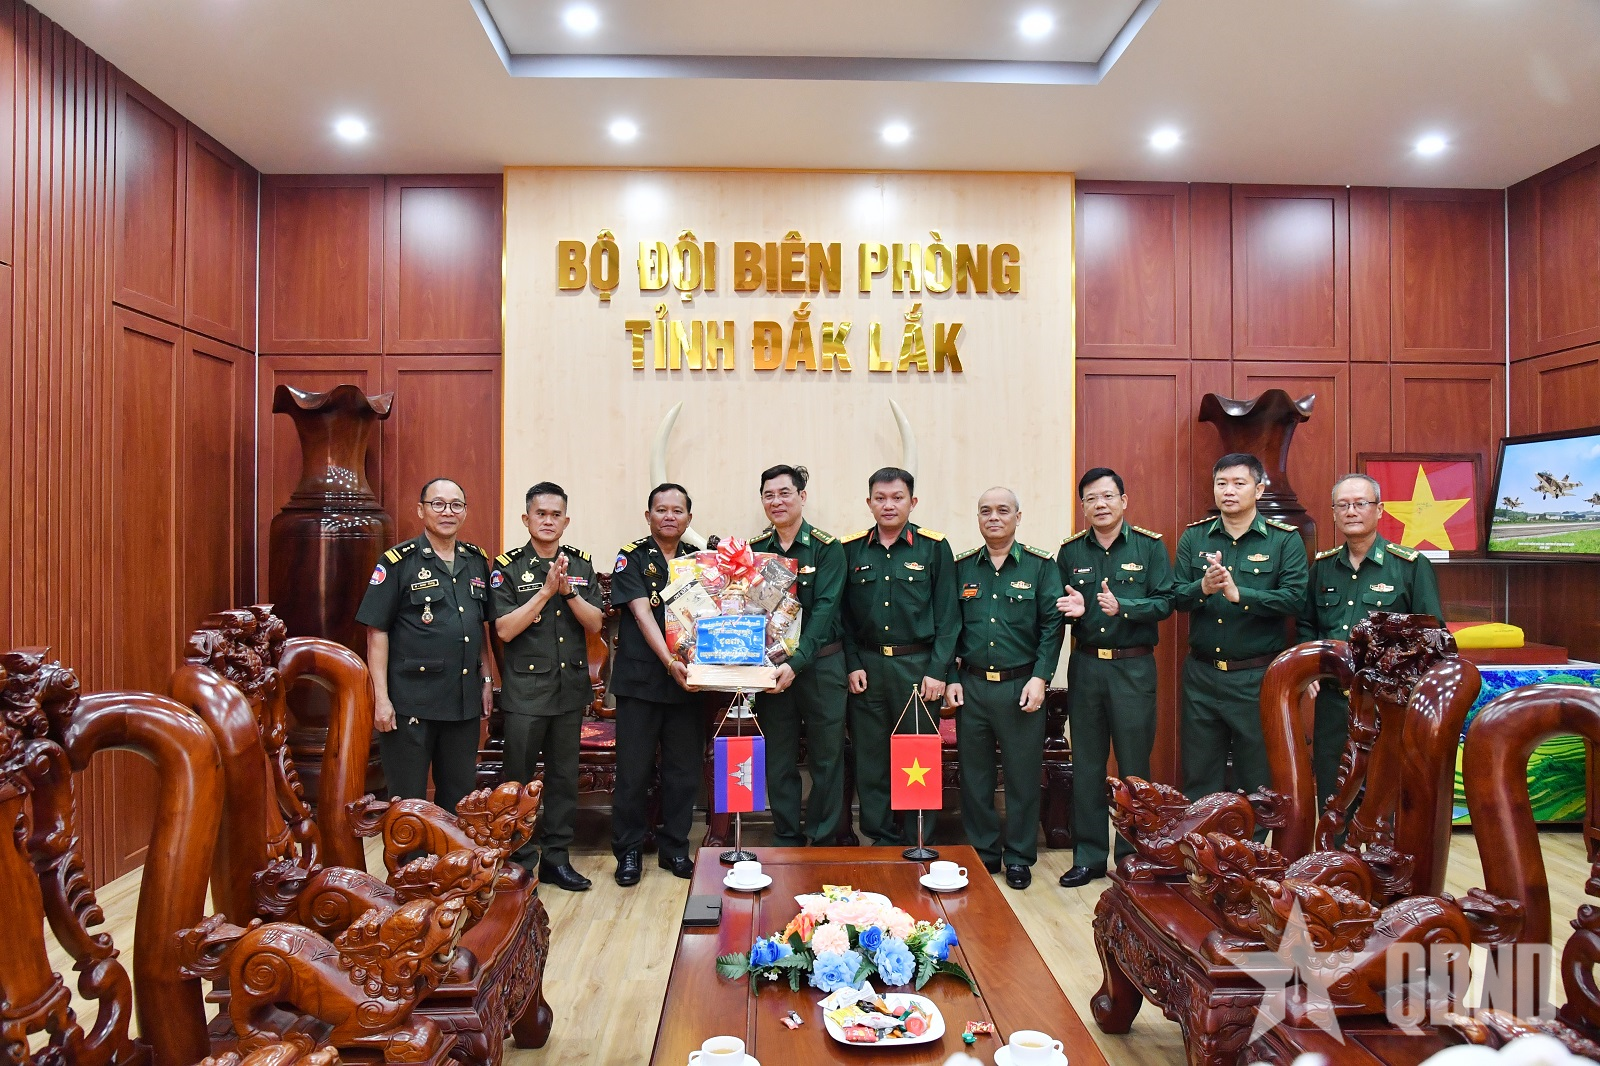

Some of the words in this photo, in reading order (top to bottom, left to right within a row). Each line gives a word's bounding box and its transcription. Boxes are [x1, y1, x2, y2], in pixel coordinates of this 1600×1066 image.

[558, 230, 620, 301] BỘ
[637, 230, 716, 301] ĐỘI
[734, 230, 841, 292] BIÊN
[858, 230, 1020, 293] PHÒNG
[625, 303, 735, 371] TỈNH
[751, 302, 852, 372] ĐẮK
[868, 303, 964, 372] LẮK
